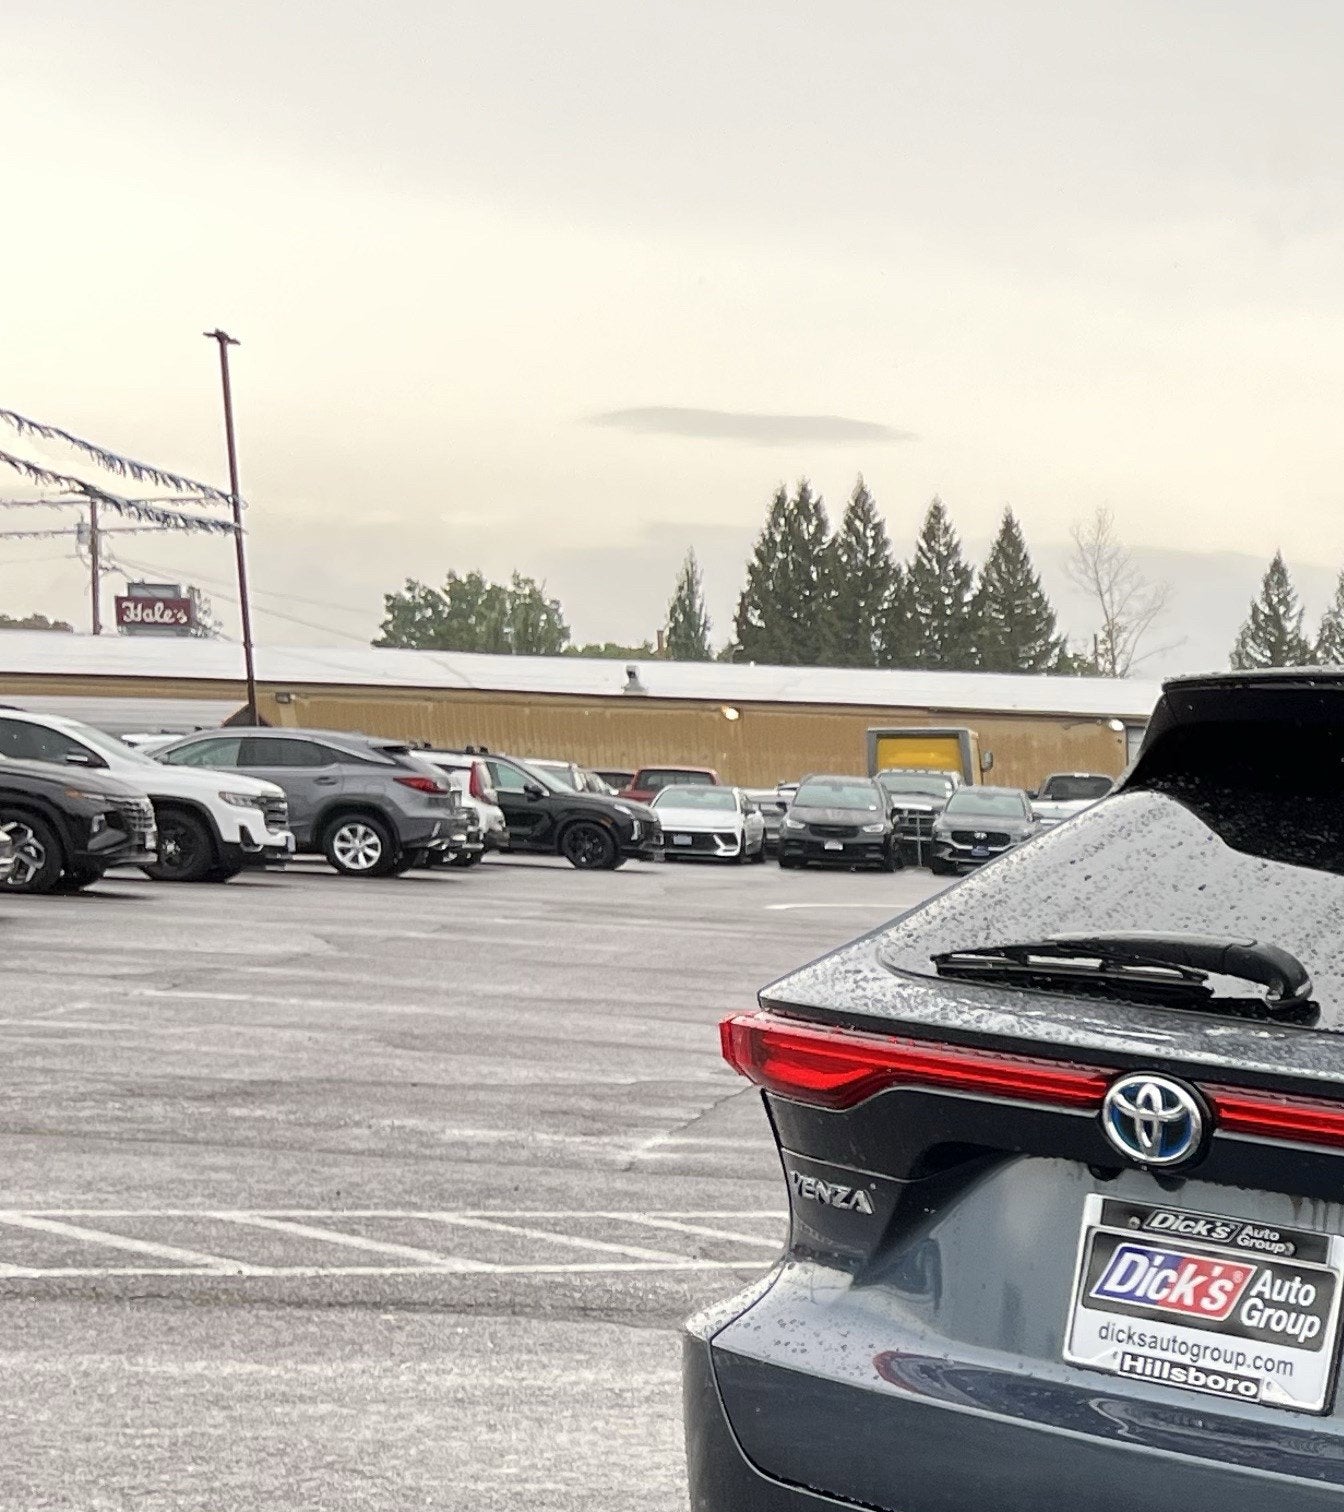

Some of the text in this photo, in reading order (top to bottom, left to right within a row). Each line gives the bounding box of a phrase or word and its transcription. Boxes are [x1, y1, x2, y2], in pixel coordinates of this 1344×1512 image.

[1149, 1212, 1231, 1240] Dick's
[1236, 1234, 1287, 1254] Group
[1242, 1224, 1281, 1242] Auto
[1103, 1251, 1235, 1312] Dick's
[1249, 1269, 1317, 1308] Auto
[1239, 1297, 1322, 1343] Group
[1097, 1321, 1295, 1378] dicksautogroup.com
[1121, 1353, 1259, 1398] Hillsboro
